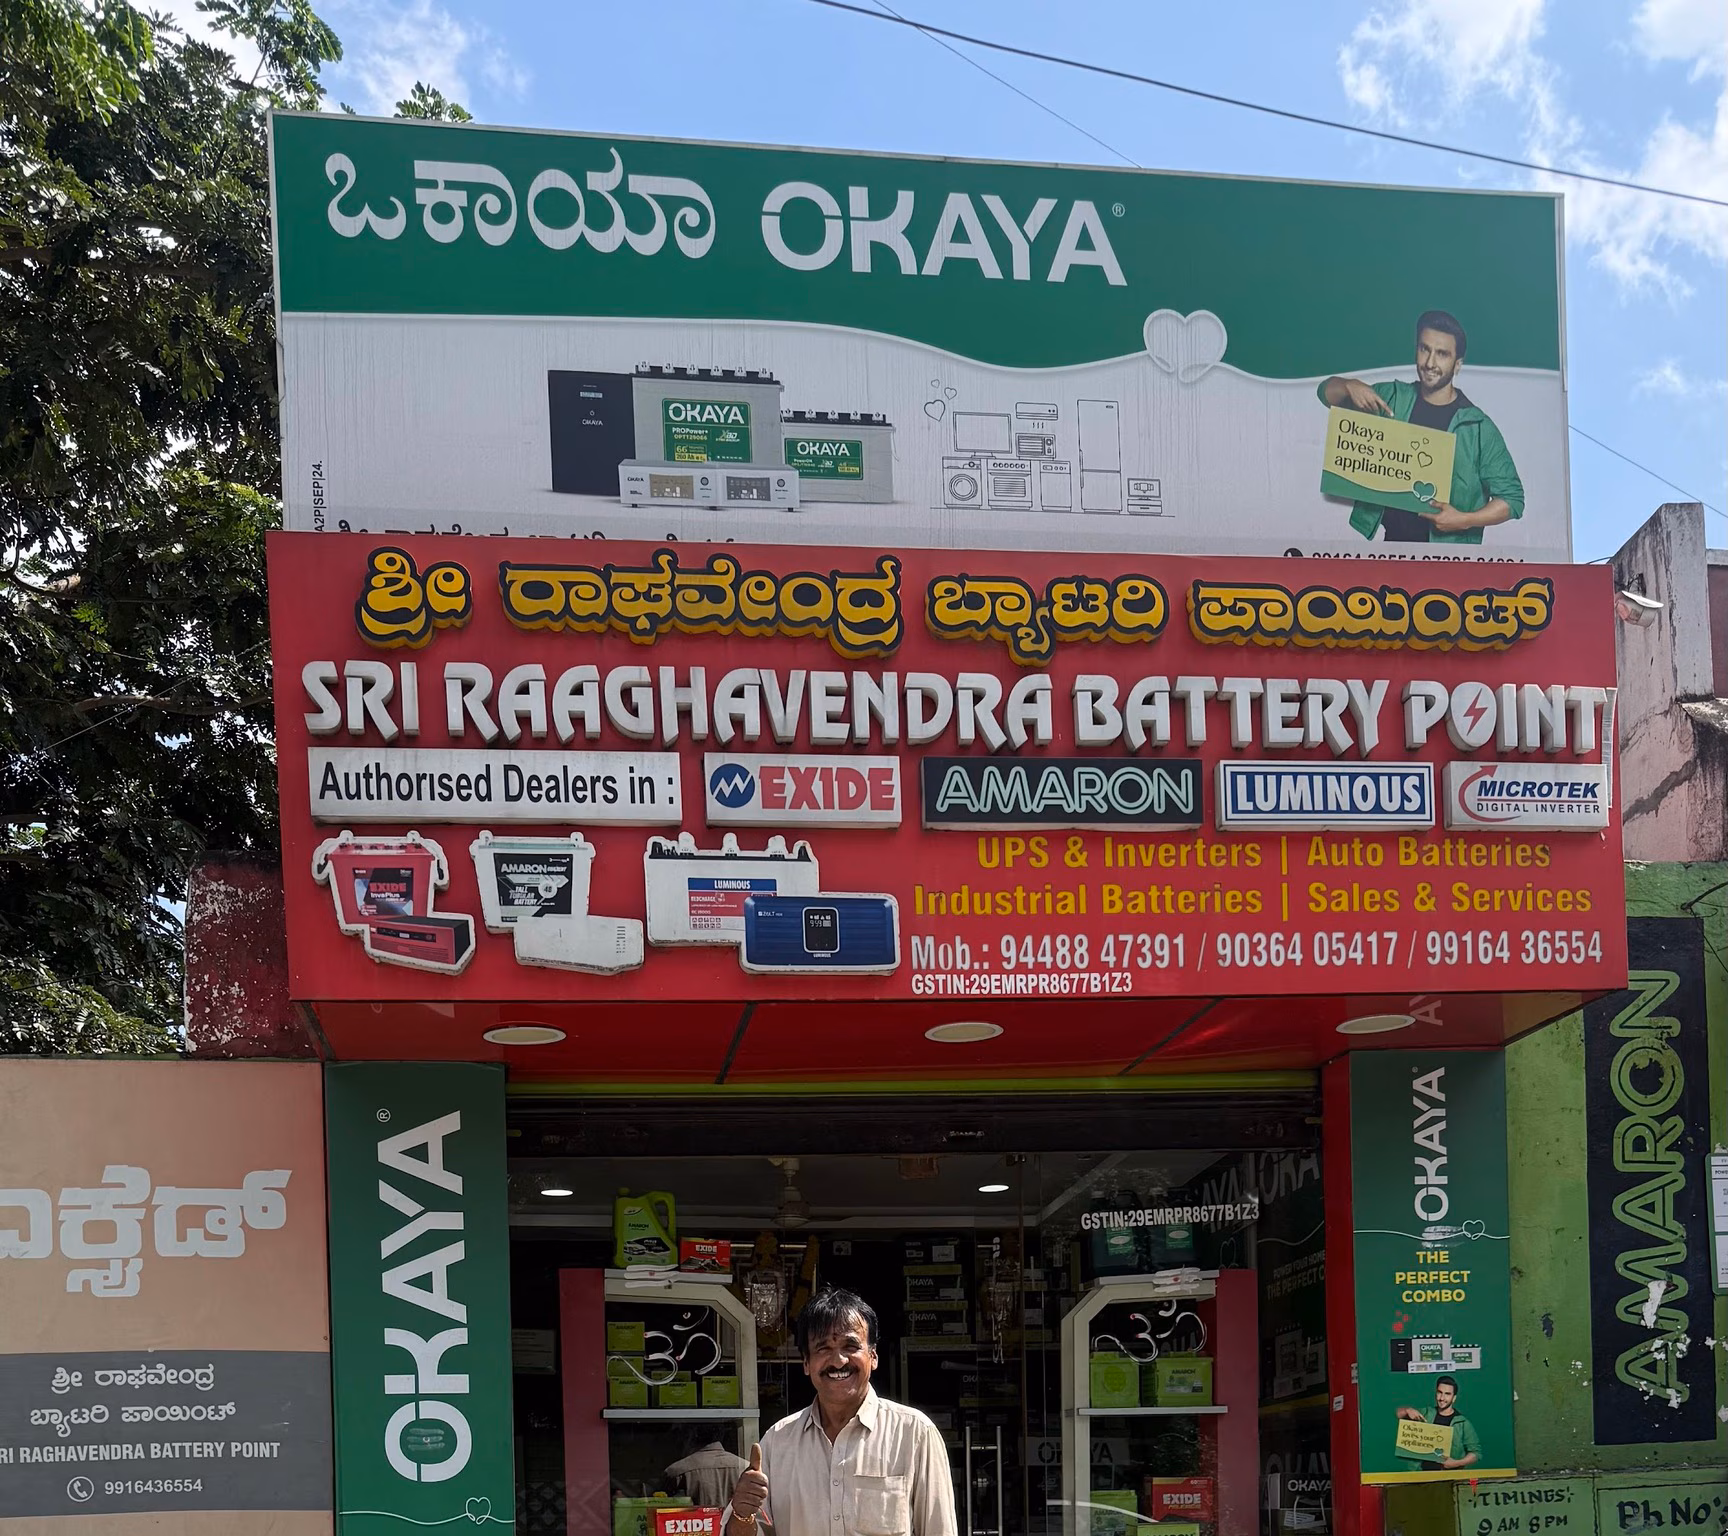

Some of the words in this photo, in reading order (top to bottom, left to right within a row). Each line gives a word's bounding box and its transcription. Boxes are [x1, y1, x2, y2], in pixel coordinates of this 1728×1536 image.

[325, 147, 716, 259] ಒಕಾಯಾ
[761, 181, 1128, 286] OKAYA
[668, 402, 745, 424] OKAYA
[1338, 419, 1384, 441] Okaya
[797, 441, 851, 456] OKAYA
[1336, 435, 1374, 456] loves
[1378, 448, 1413, 464] your
[1334, 455, 1412, 481] appliances
[357, 547, 472, 648] ಶ್ರೀ
[502, 549, 903, 657] ರಾಘವೇಂದ್ರ
[927, 575, 1170, 665] ಬ್ಯಾಟರಿ
[1188, 577, 1553, 651] ಪಾಯಿಂಟ್
[301, 660, 419, 742] SRI
[445, 662, 1053, 752] RAAGHAVENDRA
[1073, 674, 1390, 757] BATTERY
[1403, 680, 1613, 756] POINT
[319, 760, 492, 803] Authorised
[505, 763, 619, 805] Dealers
[760, 766, 895, 811] EXIDE
[935, 764, 1194, 816] AMARON
[1235, 771, 1423, 814] LUMINOUS
[1476, 777, 1600, 800] MICROTEK
[1476, 802, 1531, 814] DIGITAL
[1534, 803, 1600, 815] INVERTER
[978, 834, 1049, 869] UPS
[1066, 836, 1090, 868] &
[1105, 834, 1263, 868] Inverters
[1307, 835, 1384, 867] Auto
[1400, 836, 1551, 868] Batteries
[501, 863, 548, 874] AMARON
[369, 882, 407, 892] EXIDE
[714, 880, 751, 890] LUMINOUS
[914, 883, 1088, 917] Industrial
[1102, 882, 1263, 915] Batteries
[1308, 880, 1400, 913] Sales
[1413, 882, 1437, 912] &
[1451, 880, 1593, 912] Services
[1000, 933, 1090, 968] 94488
[1100, 933, 1186, 968] 47391
[1216, 933, 1304, 968] 90364
[1312, 932, 1398, 968] 05417
[1426, 930, 1511, 965] 99164
[1519, 930, 1602, 965] 36554
[911, 973, 1133, 996] GSTIN:29EMRPR8677B1Z3
[1413, 1066, 1449, 1223] OKAYA
[1609, 970, 1691, 1404] AMARON
[1081, 1203, 1260, 1230] GSTIN:29EMRPR8677B1Z3
[696, 1244, 717, 1253] EXIDE
[1416, 1250, 1450, 1265] THE
[1395, 1269, 1471, 1286] PERFECT
[377, 1110, 473, 1484] OKAYA
[1402, 1287, 1466, 1304] COMBO
[51, 1366, 83, 1394] ಶ್ರೀ
[95, 1363, 215, 1391] ರಾಘವೇಂದ್ರ
[30, 1404, 109, 1438] ಬ್ಯಾಟರಿ
[121, 1402, 236, 1423] ಪಾಯಿಂಟ್
[1402, 1424, 1423, 1433] Okaya
[20, 1443, 145, 1463] RAGHAVENDRA
[150, 1442, 225, 1459] BATTERY
[231, 1442, 280, 1458] POINT
[104, 1479, 203, 1495] 9916436554
[1162, 1493, 1201, 1506] EXIDE
[665, 1518, 713, 1534] EXIDE
[1477, 1518, 1493, 1536] 9
[1497, 1517, 1520, 1533] AM
[1529, 1516, 1540, 1534] 8
[1545, 1515, 1568, 1528] PM
[1616, 1500, 1665, 1530] Ph
